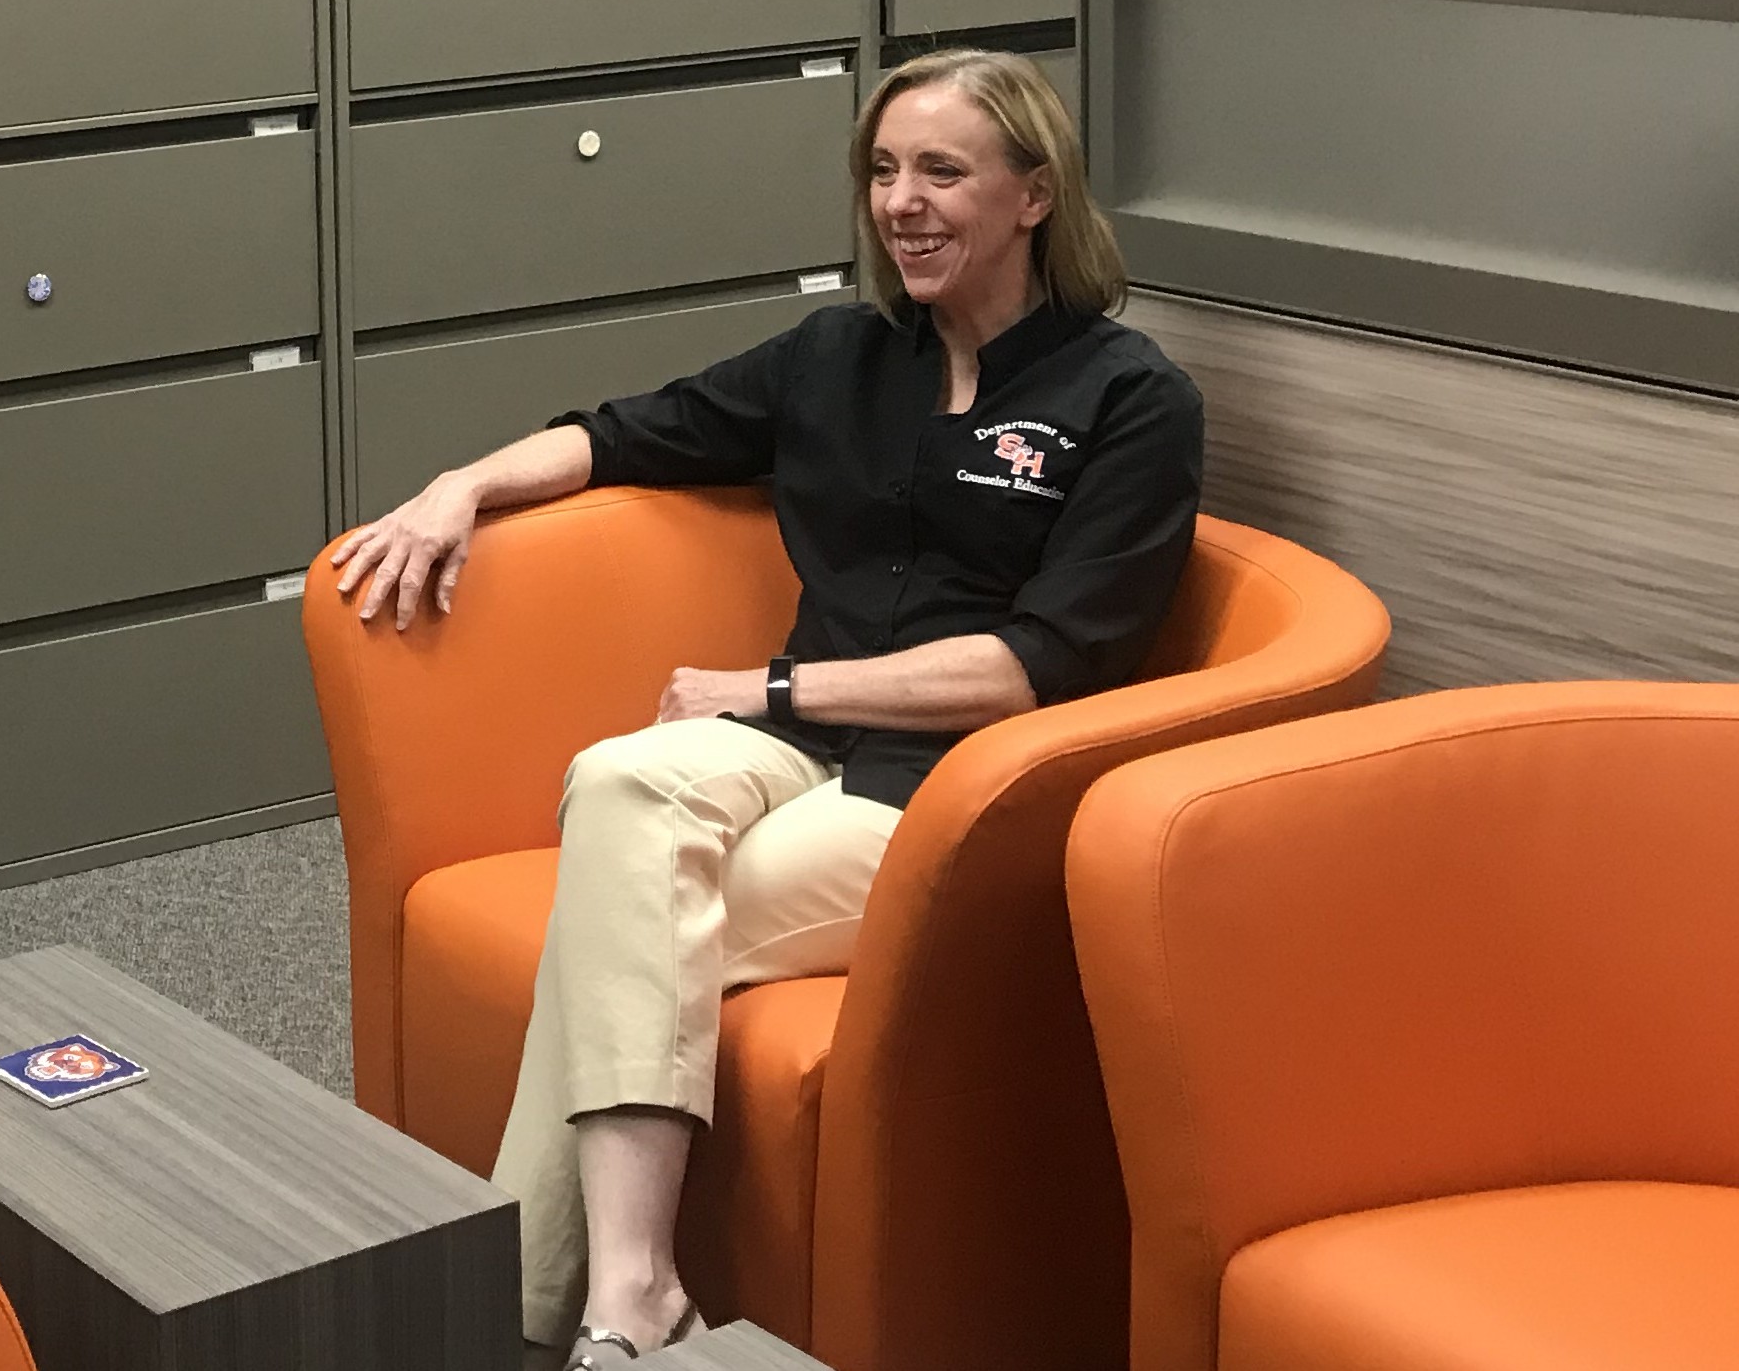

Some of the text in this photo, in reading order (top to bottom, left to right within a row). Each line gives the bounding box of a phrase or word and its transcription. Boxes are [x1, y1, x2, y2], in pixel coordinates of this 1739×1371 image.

[973, 420, 1078, 452] Department of
[956, 469, 1012, 489] Counselor
